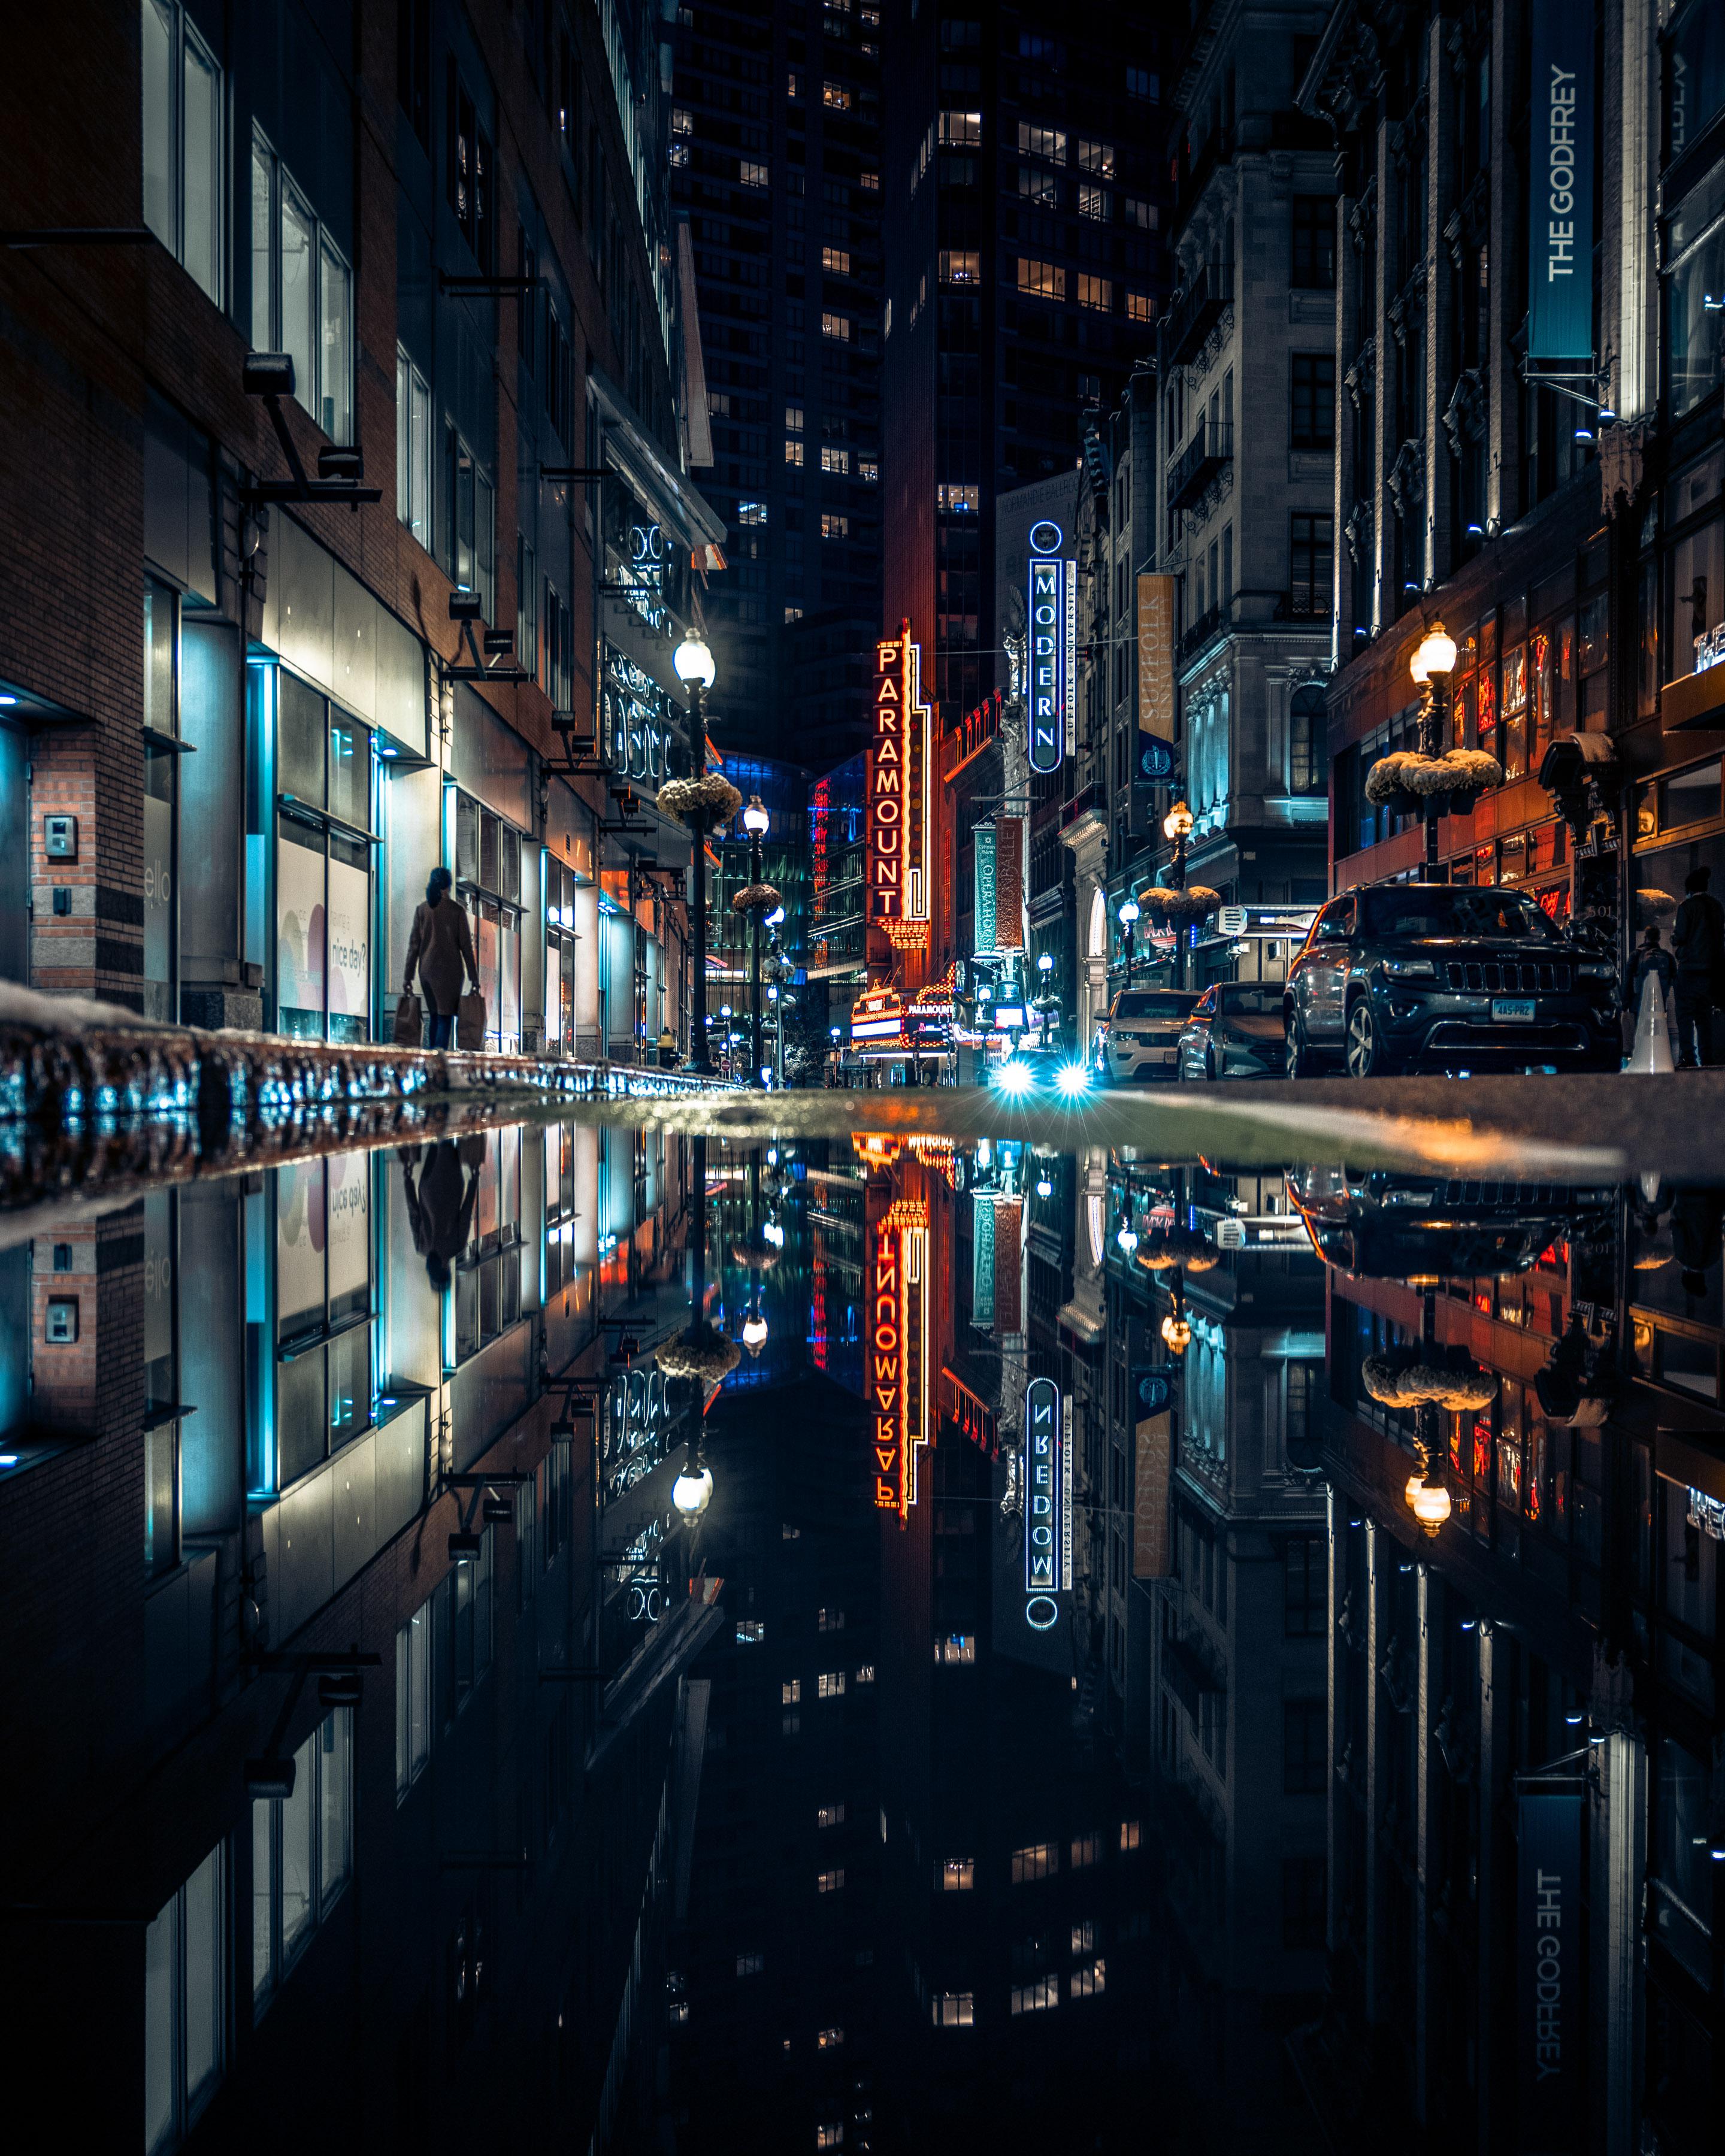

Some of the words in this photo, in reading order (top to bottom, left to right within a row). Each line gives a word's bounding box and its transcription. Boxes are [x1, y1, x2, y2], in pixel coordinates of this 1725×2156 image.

[1550, 63, 1576, 213] GODFREY
[1548, 222, 1573, 281] THE
[1036, 576, 1056, 747] MODERN
[1141, 595, 1159, 719] SUFFOLK
[1160, 595, 1172, 719] UNIVERSITY
[876, 648, 900, 915] PARAMOUNT
[983, 864, 994, 906] OPERA
[1588, 906, 1612, 917] 501
[332, 938, 347, 967] nice
[349, 939, 366, 977] day?
[983, 909, 993, 950] HOUSE
[909, 1005, 952, 1015] PARAMOUNT
